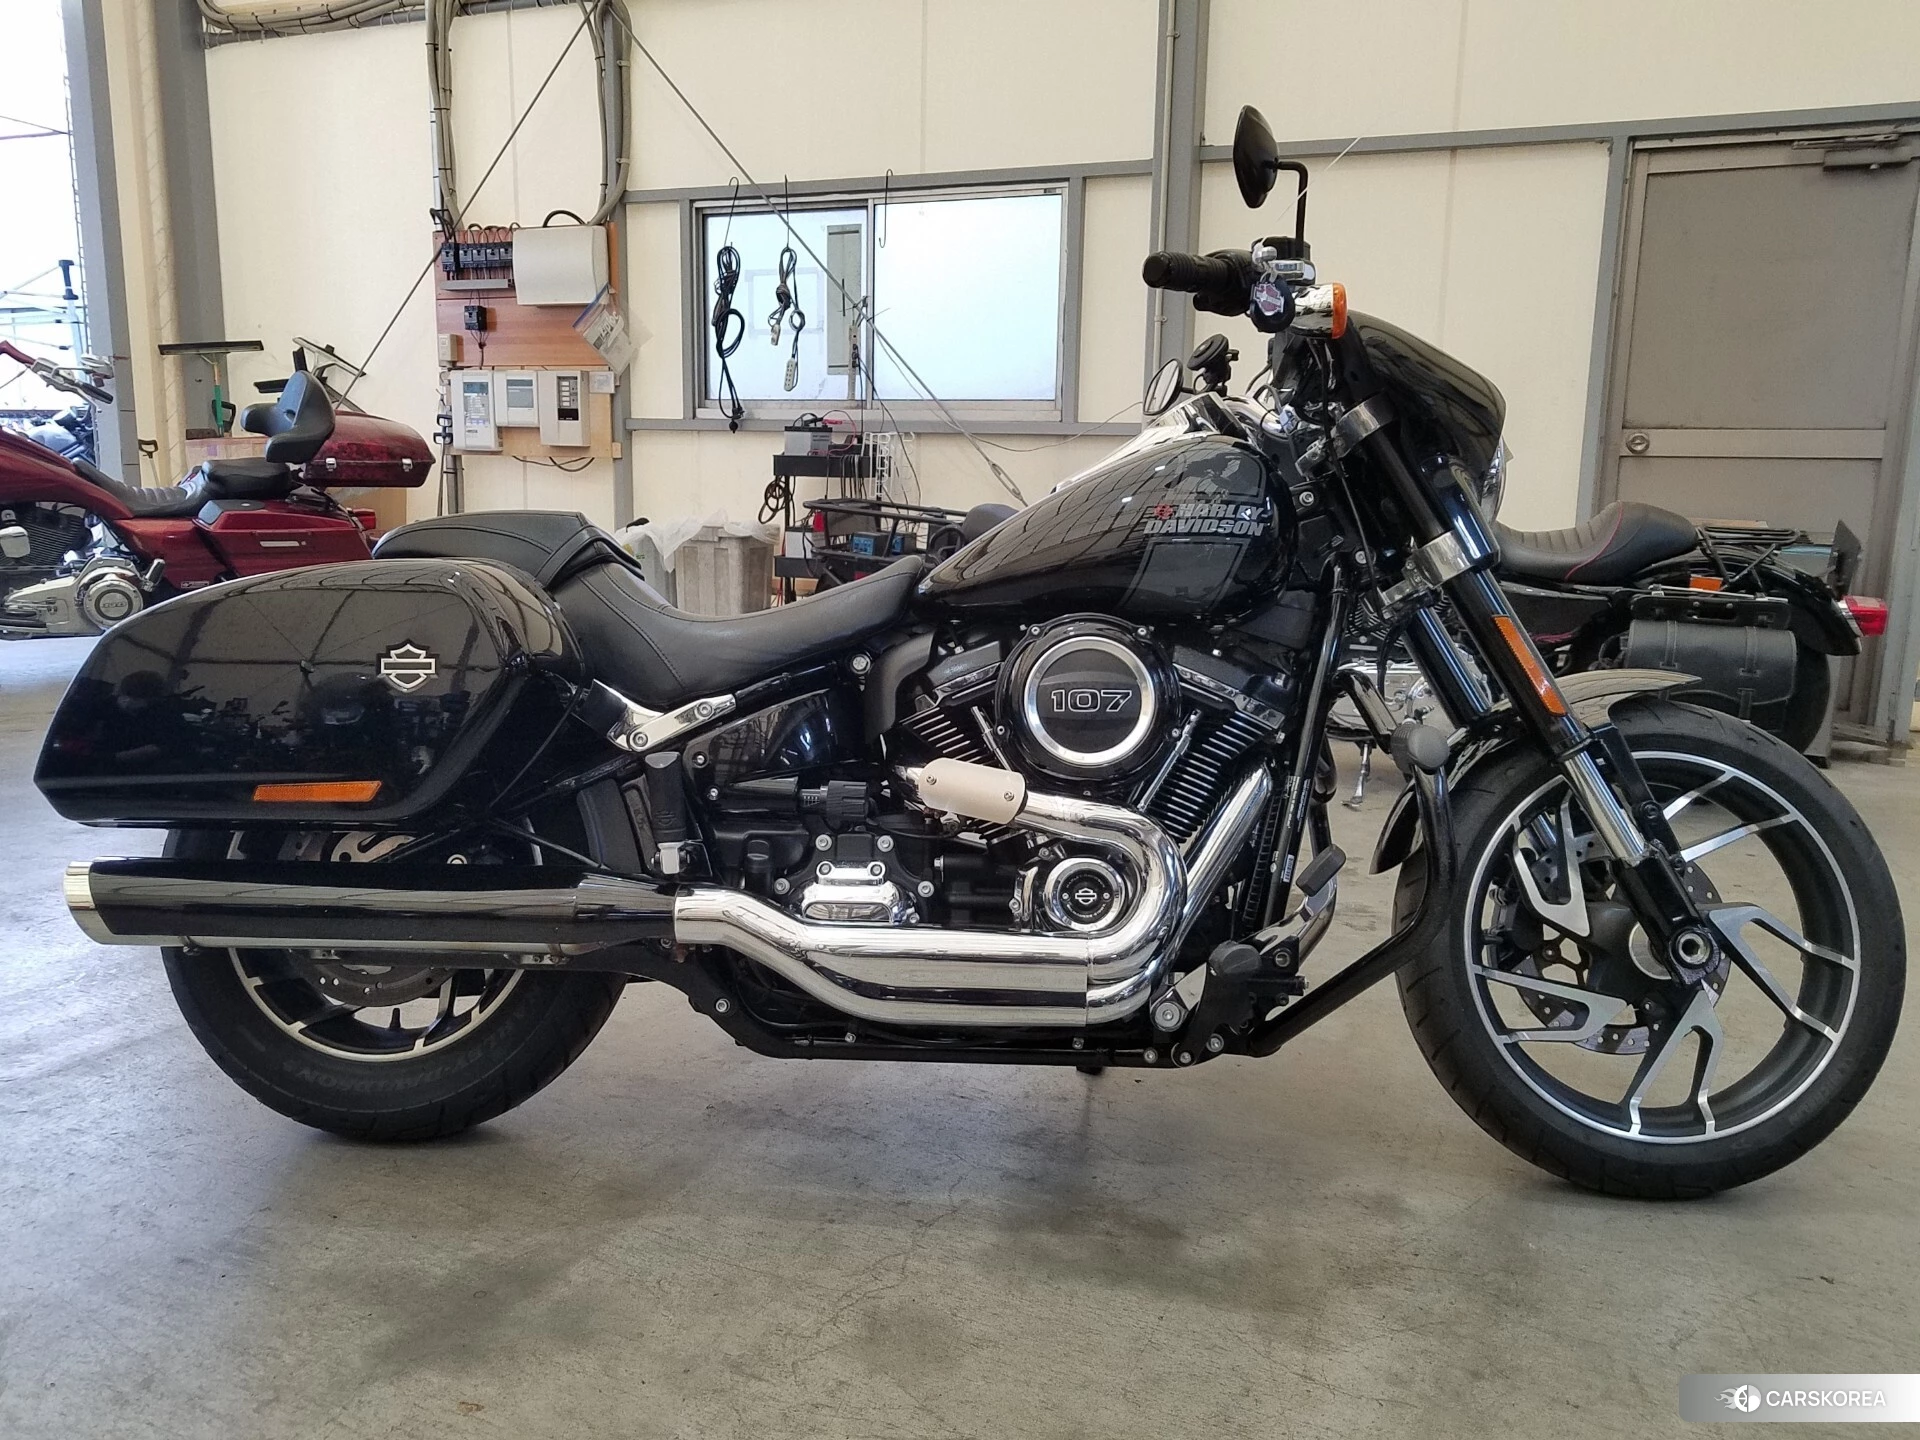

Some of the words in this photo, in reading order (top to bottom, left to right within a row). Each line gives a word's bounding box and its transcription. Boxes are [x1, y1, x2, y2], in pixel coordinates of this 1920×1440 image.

[1175, 503, 1269, 519] HARLEY-
[1143, 518, 1264, 536] DAVIDSON
[1051, 689, 1132, 712] 107
